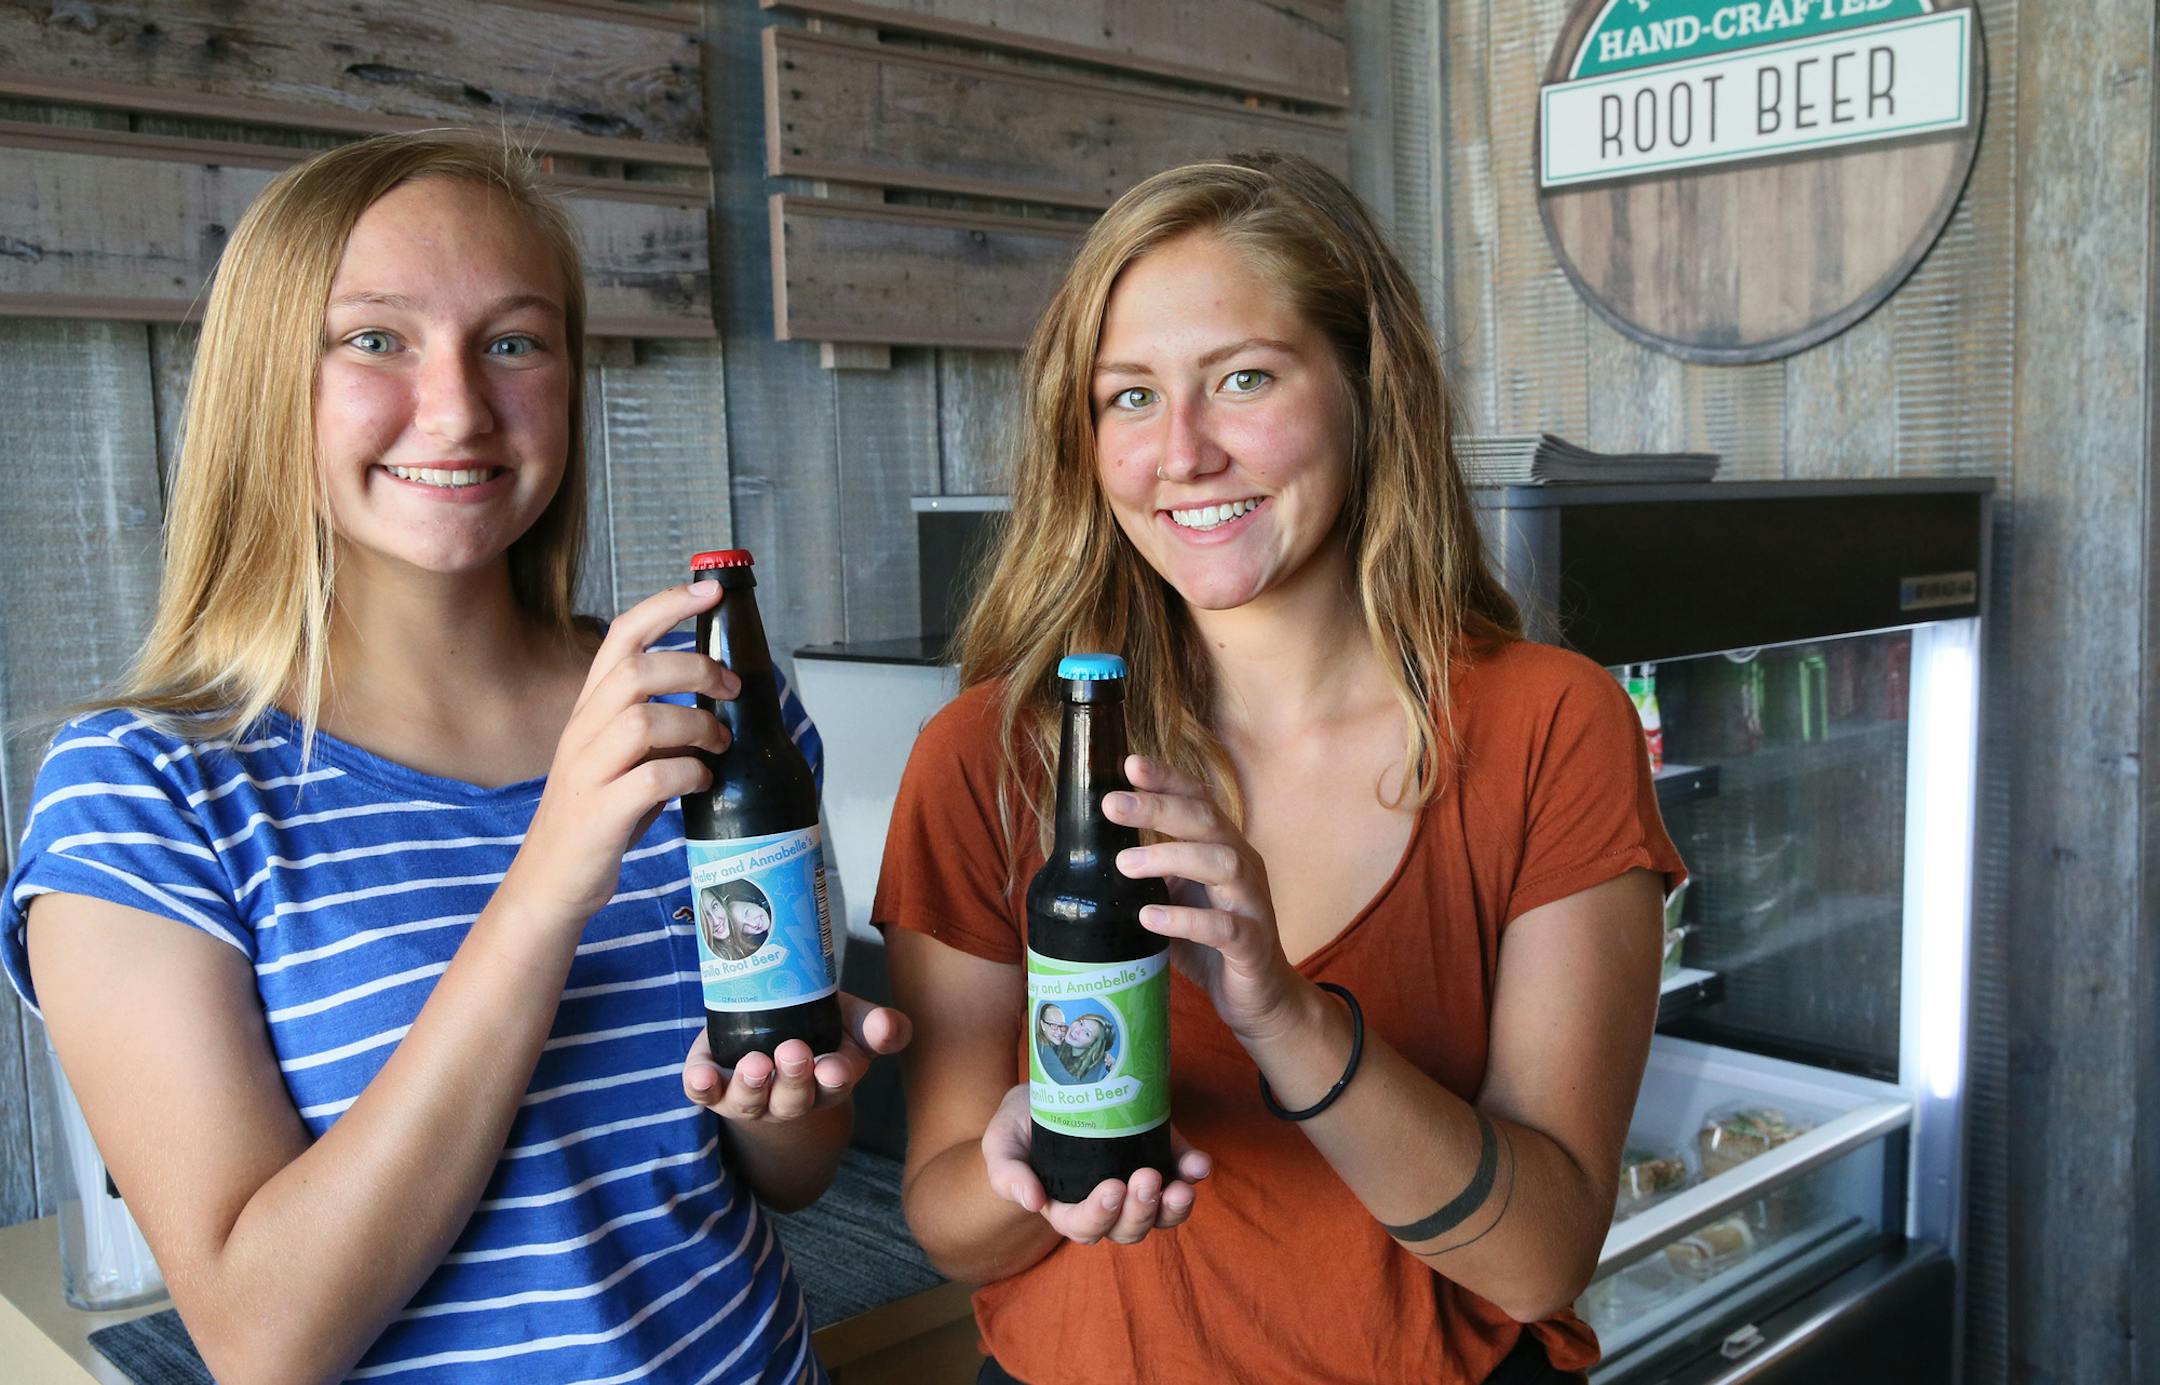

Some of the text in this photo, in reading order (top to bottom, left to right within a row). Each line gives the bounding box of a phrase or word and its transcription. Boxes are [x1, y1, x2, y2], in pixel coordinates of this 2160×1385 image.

[1601, 46, 1896, 159] ROOT BEER
[721, 860, 745, 877] and
[749, 836, 813, 870] Annabelle's
[722, 959, 748, 975] Root
[752, 951, 780, 966] Beer
[1042, 979, 1062, 995] and
[1066, 966, 1147, 993] Annabelle's
[1057, 1091, 1090, 1104] Root
[1095, 1085, 1129, 1101] Beer
